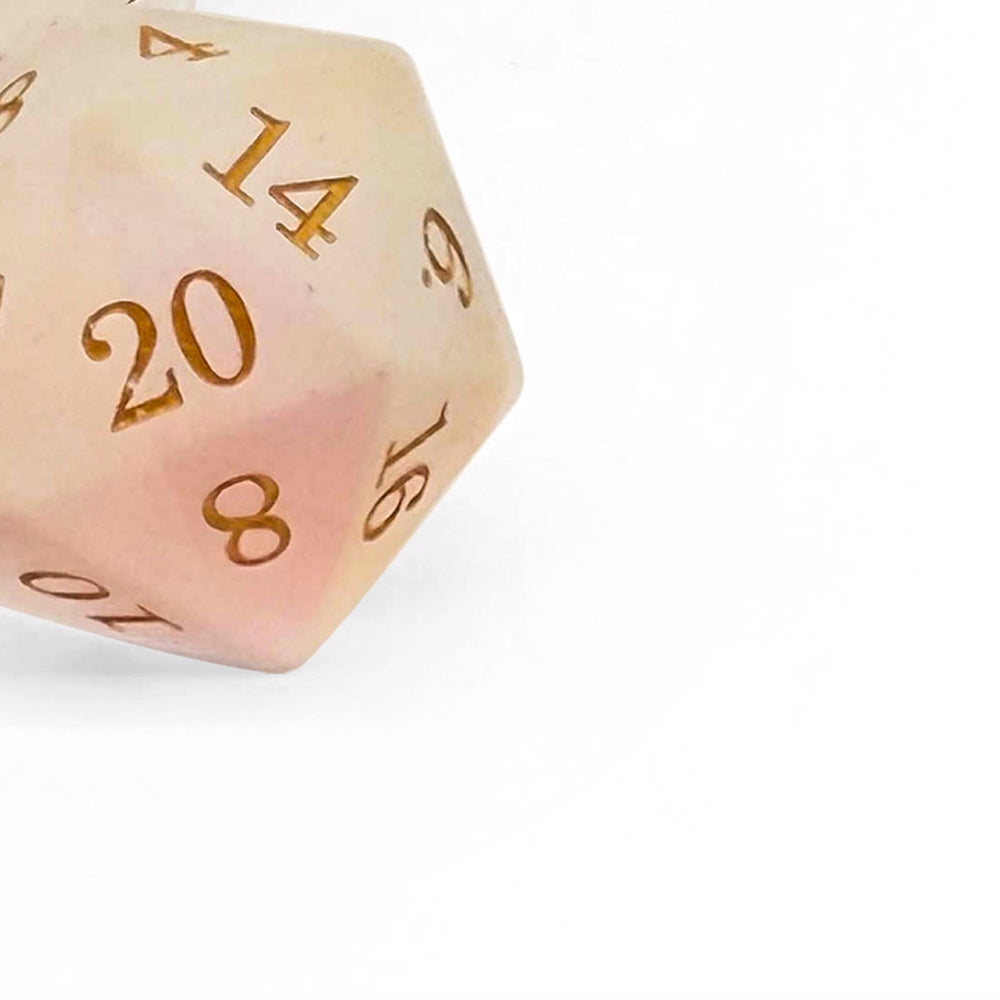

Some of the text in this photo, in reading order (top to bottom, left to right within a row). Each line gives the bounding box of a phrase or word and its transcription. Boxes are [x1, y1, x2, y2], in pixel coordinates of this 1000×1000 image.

[138, 24, 231, 62] 4
[202, 106, 359, 260] 14
[81, 268, 258, 433] 20
[201, 473, 292, 567] 8
[362, 400, 448, 542] 16
[18, 569, 185, 632] 10
